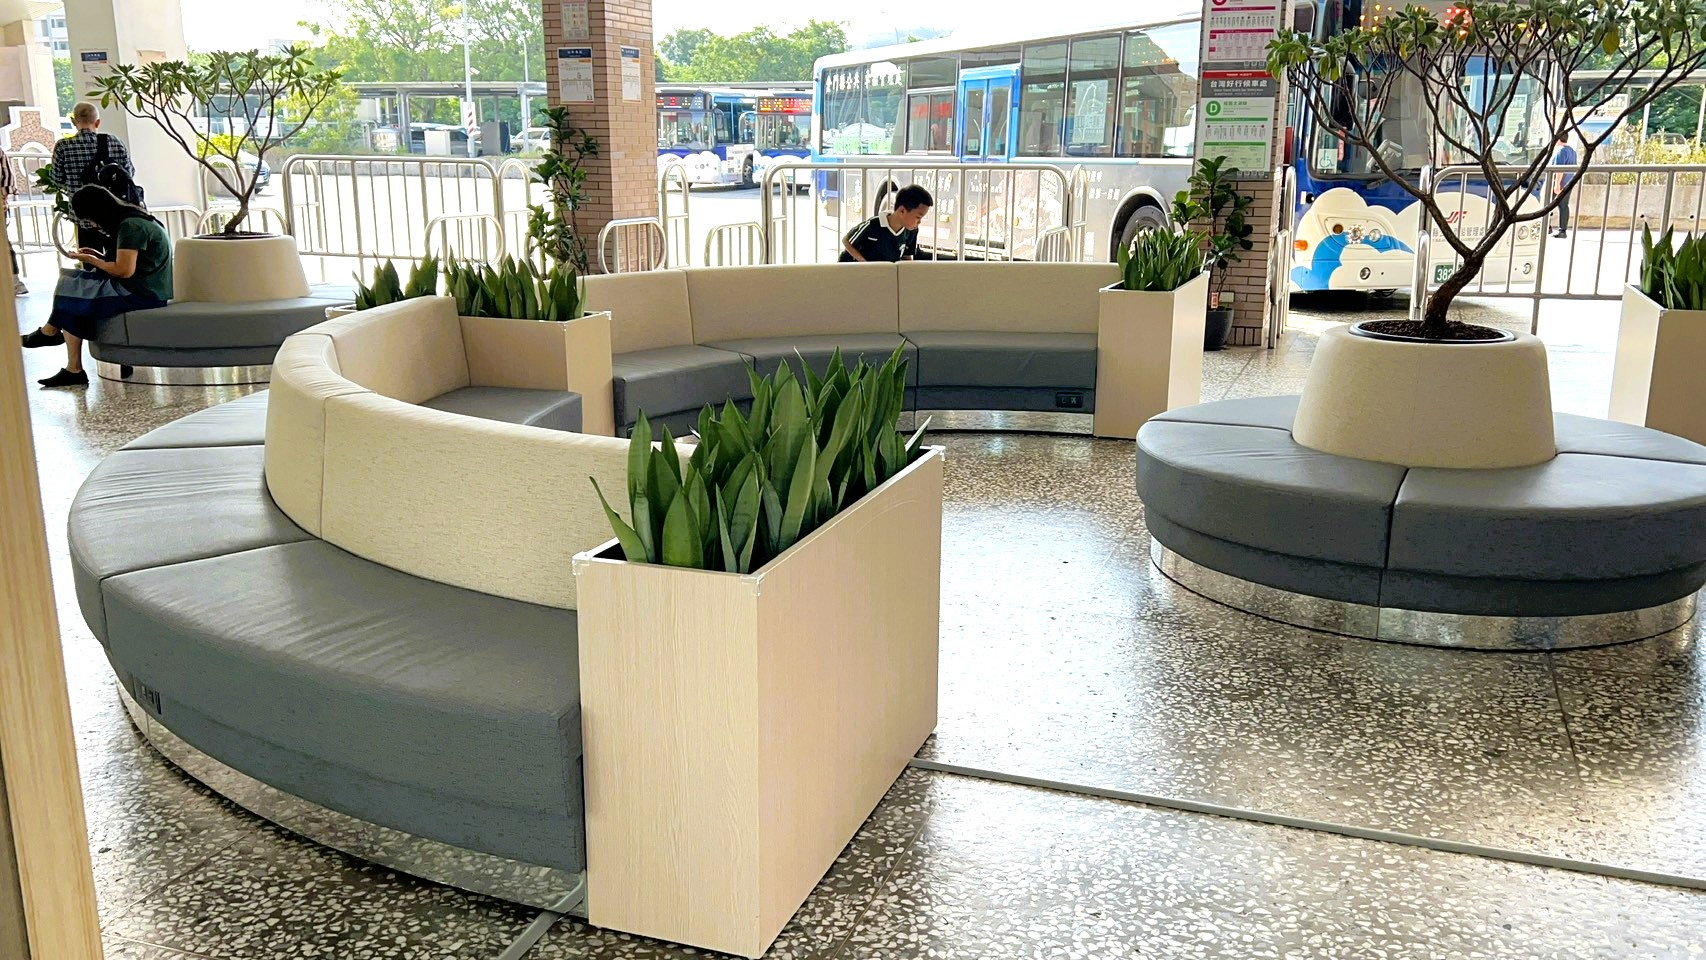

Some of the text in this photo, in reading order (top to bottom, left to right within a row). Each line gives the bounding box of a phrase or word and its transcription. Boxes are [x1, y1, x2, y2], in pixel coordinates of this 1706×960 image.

[1210, 79, 1268, 88] 台灣好行候車處
[1209, 103, 1218, 113] D
